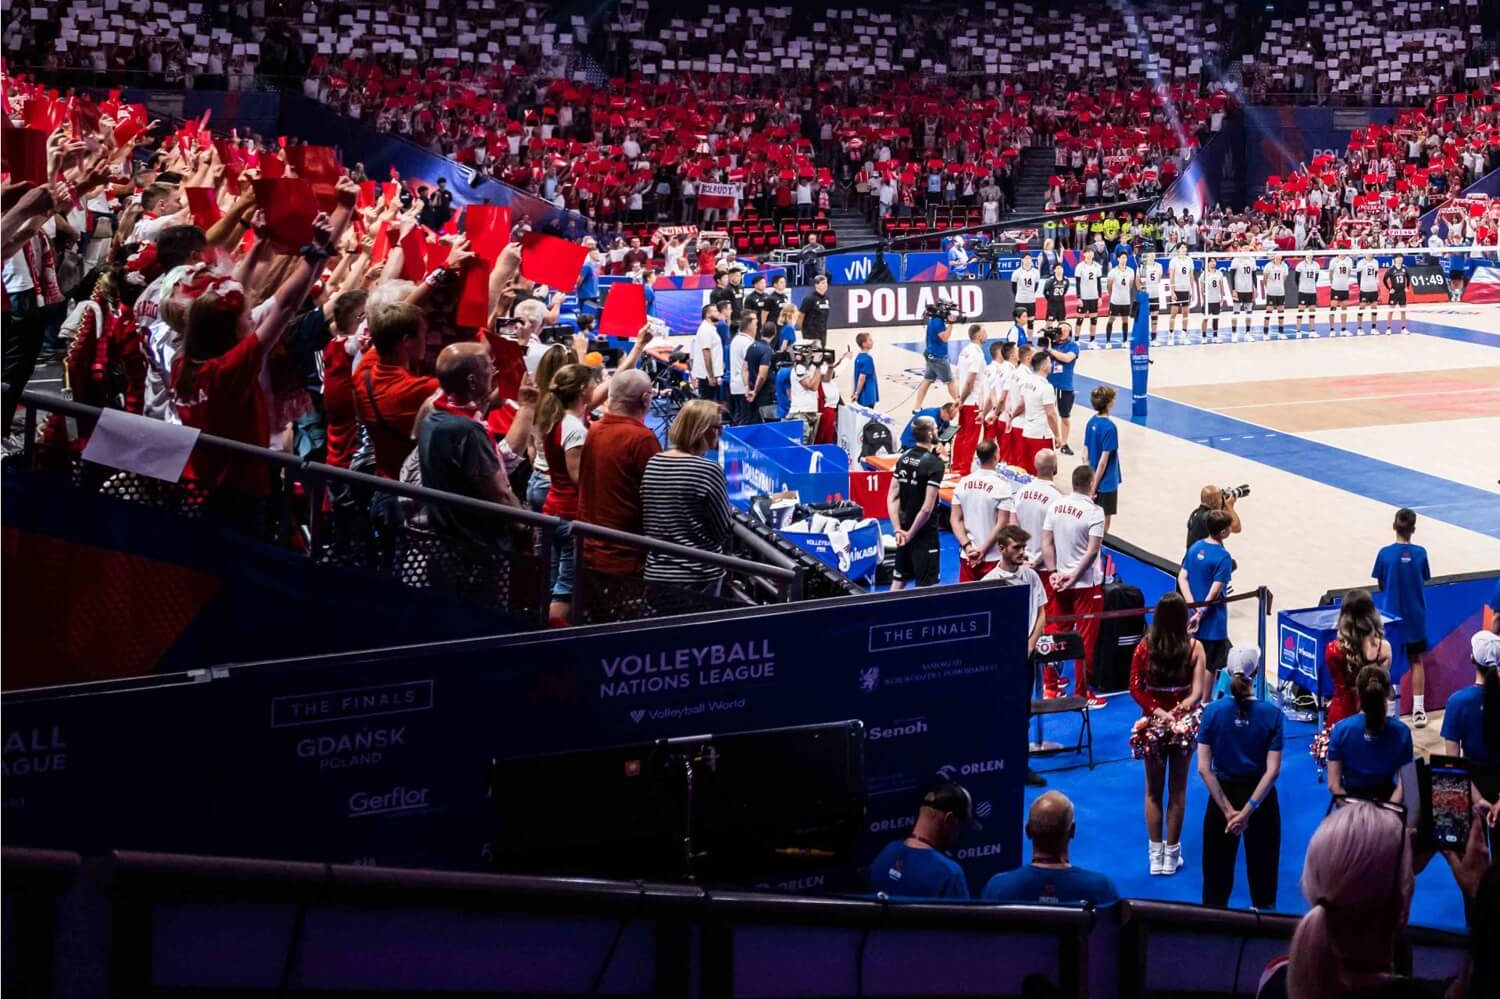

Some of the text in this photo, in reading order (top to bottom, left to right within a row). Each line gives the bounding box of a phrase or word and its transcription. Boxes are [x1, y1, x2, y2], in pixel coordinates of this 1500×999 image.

[1088, 271, 1094, 280] 2
[1150, 272, 1156, 281] 5
[1181, 266, 1187, 275] 6
[1243, 266, 1251, 274] 10
[1306, 271, 1315, 279] 12
[1367, 268, 1376, 276] 21
[1023, 277, 1033, 287] 14
[1121, 278, 1127, 287] 4
[1212, 280, 1218, 288] 8
[1410, 273, 1445, 287] 01:49
[1053, 287, 1065, 297] 20
[847, 285, 984, 324] POLAND
[866, 474, 879, 492] 11
[963, 479, 994, 494] POLSKA
[1053, 504, 1084, 519] POLSKA
[884, 619, 978, 643] THE FINALS
[600, 638, 776, 680] VOLLEYBALL
[600, 661, 776, 698] NATIONS LEAGUE
[291, 689, 416, 719] THE FINALS
[648, 697, 746, 723] Volleyball World
[869, 719, 929, 740] Senoh
[296, 725, 407, 759] GDAŃSK
[319, 751, 383, 771] POLAND
[960, 759, 1005, 776] ORLEN
[348, 785, 431, 813] Gerflor
[869, 815, 914, 833] ORLEN
[956, 842, 1002, 861] ORLEN
